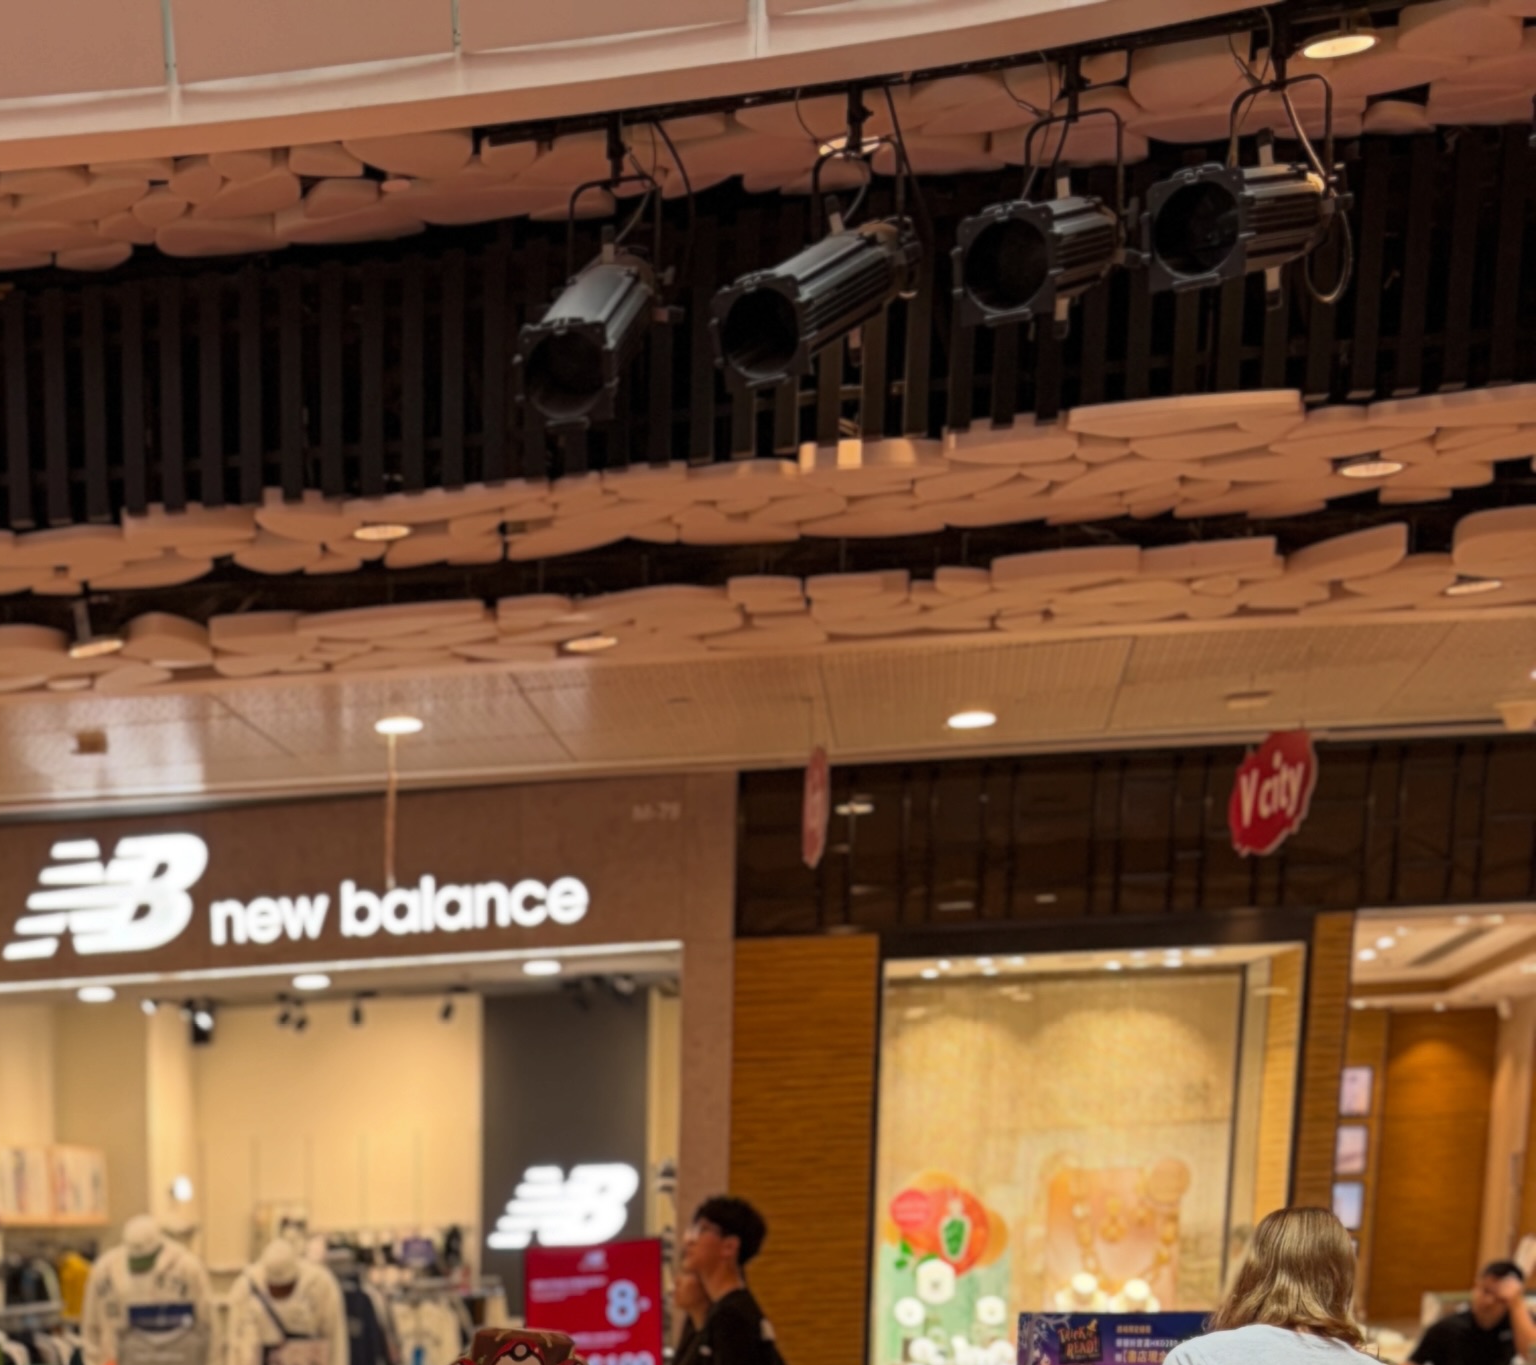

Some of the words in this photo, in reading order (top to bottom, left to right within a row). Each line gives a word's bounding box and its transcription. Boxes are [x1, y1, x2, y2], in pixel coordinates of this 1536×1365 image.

[1258, 750, 1309, 817] city
[210, 894, 329, 946] new
[340, 875, 589, 938] balance
